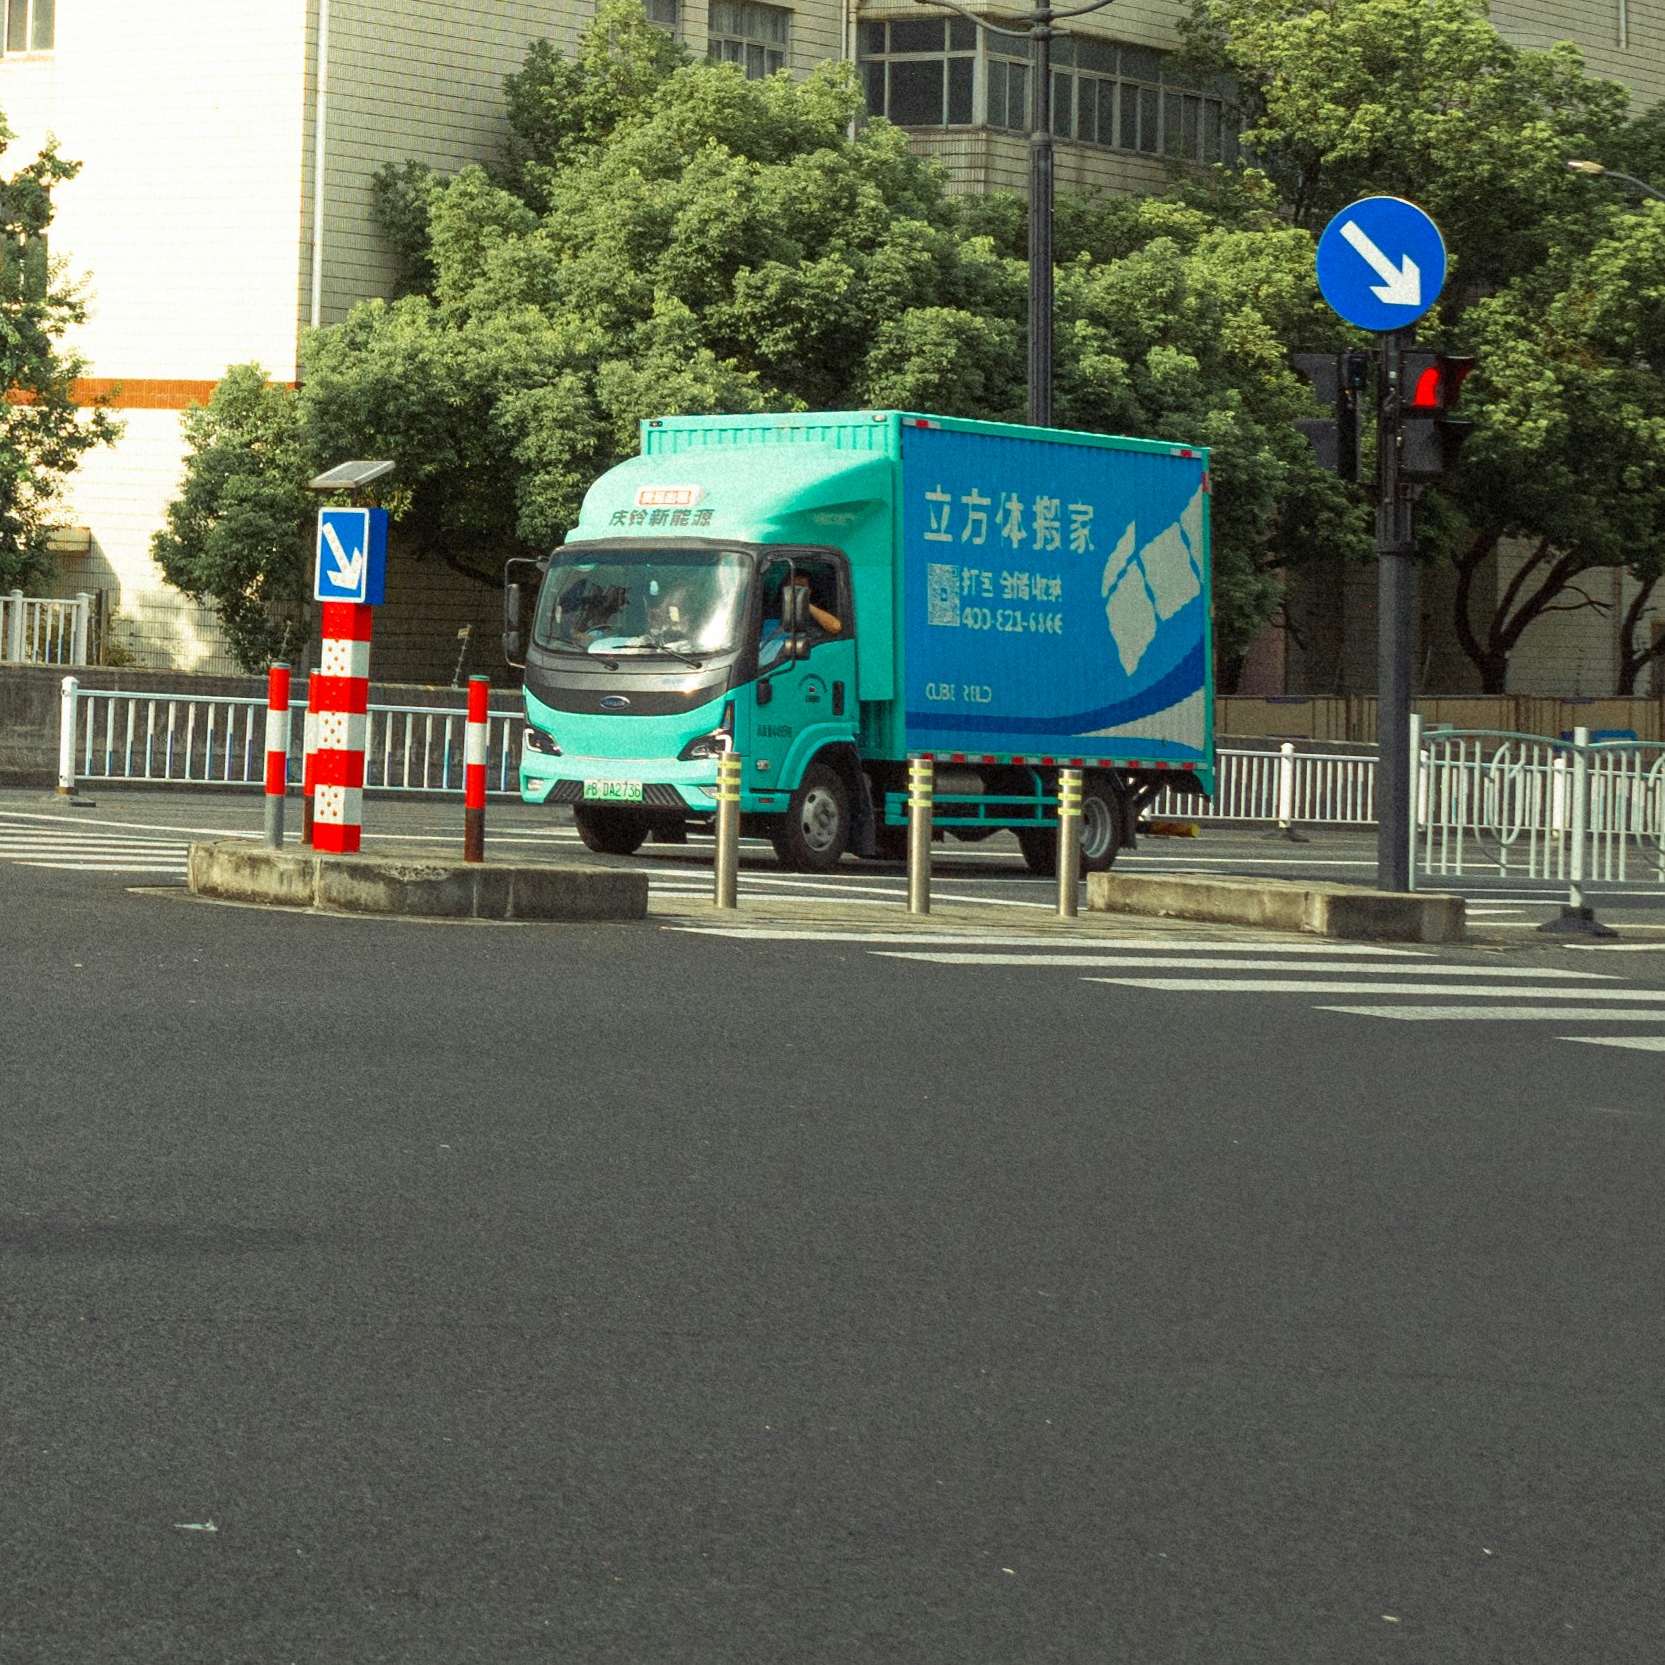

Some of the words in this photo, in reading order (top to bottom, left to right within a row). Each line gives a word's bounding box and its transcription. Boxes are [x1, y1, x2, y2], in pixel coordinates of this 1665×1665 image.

[609, 509, 715, 526] 庆铃新能源
[924, 484, 1095, 554] 立方体搬家
